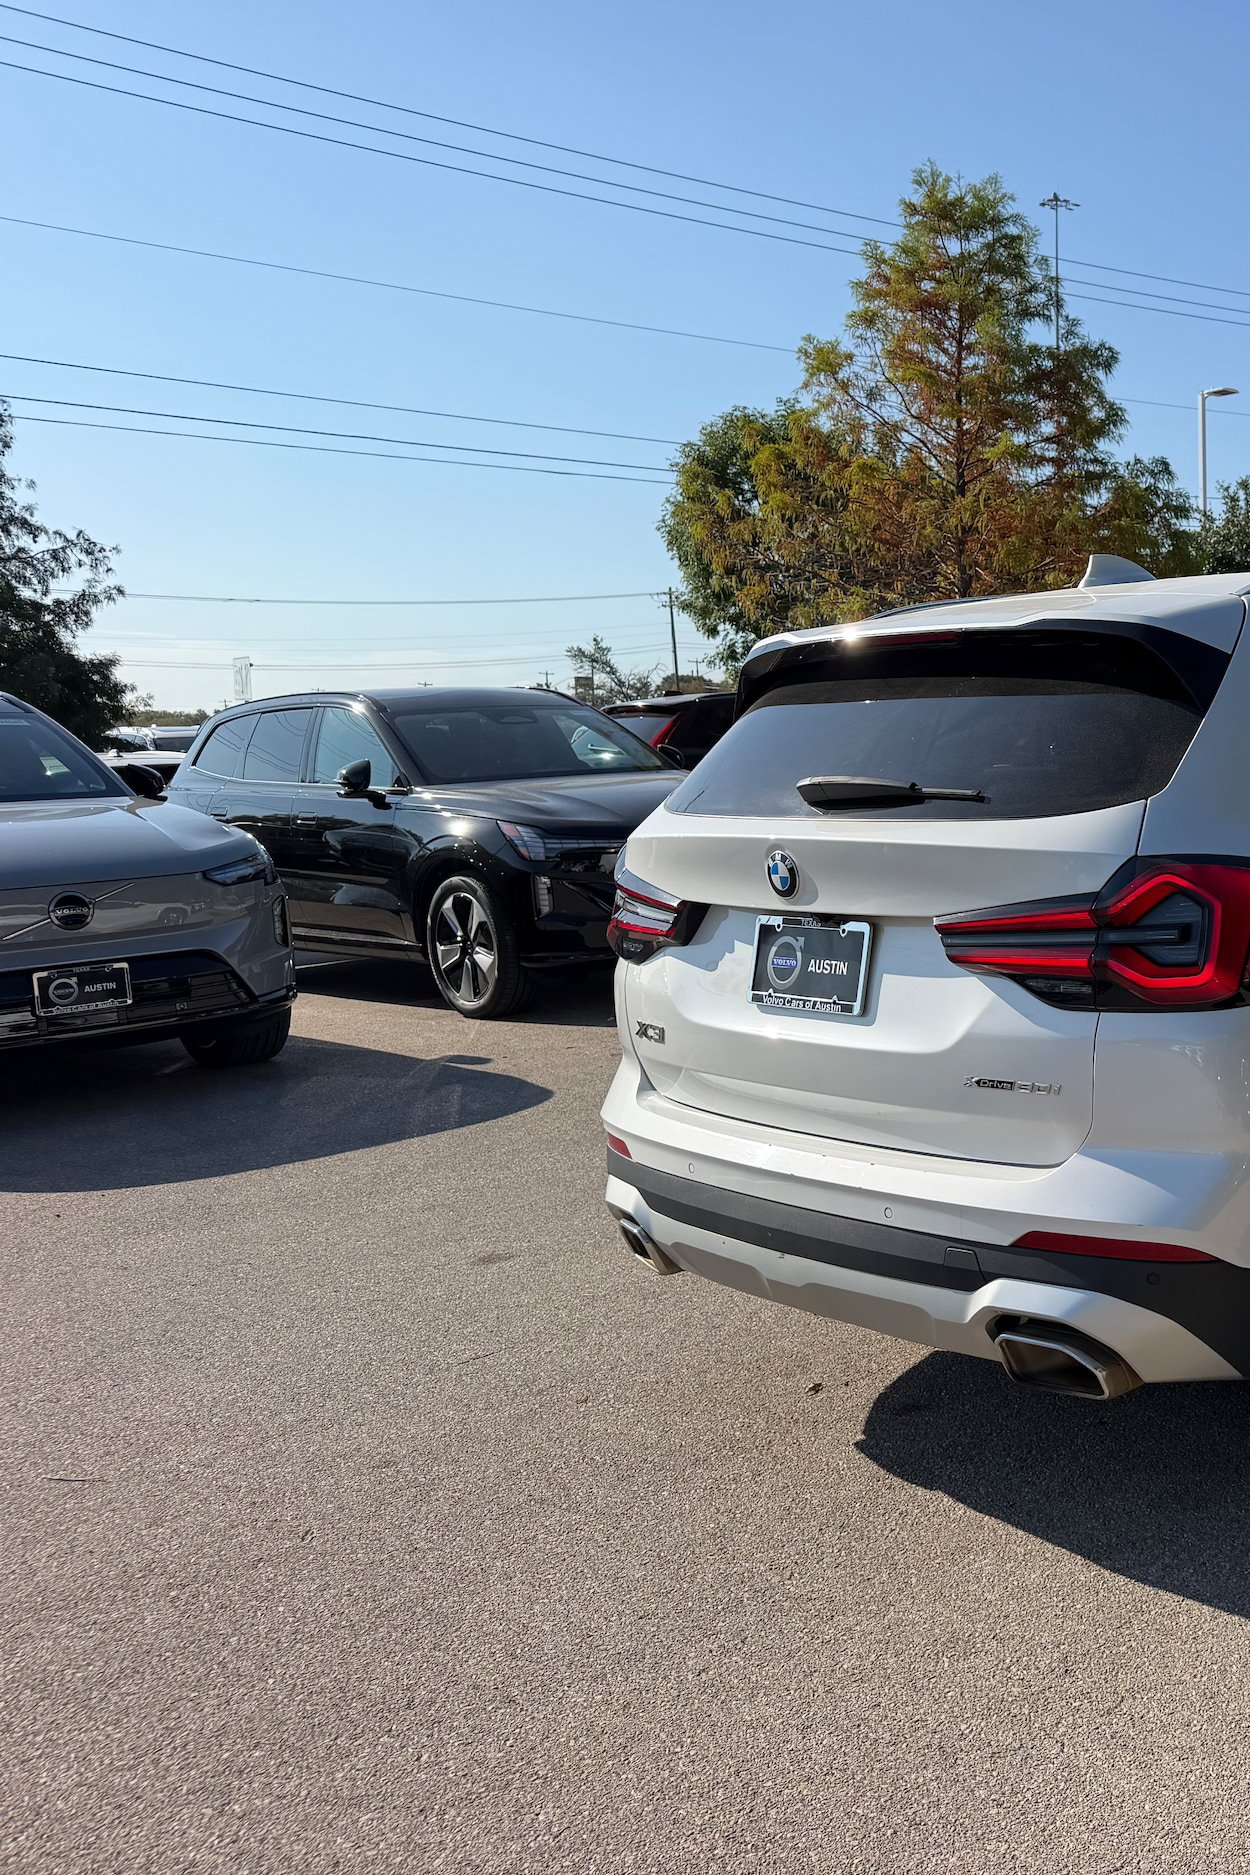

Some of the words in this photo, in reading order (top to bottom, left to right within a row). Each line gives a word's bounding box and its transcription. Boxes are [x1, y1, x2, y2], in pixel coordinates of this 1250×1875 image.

[768, 852, 793, 869] BMW
[772, 958, 797, 966] VOLVO
[807, 958, 848, 975] AUSTIN
[84, 982, 116, 993] AUSTIN
[762, 994, 784, 1006] Volvo
[785, 997, 804, 1009] Cars
[804, 1000, 814, 1010] of
[815, 1001, 842, 1013] Austin
[636, 1021, 665, 1044] X3
